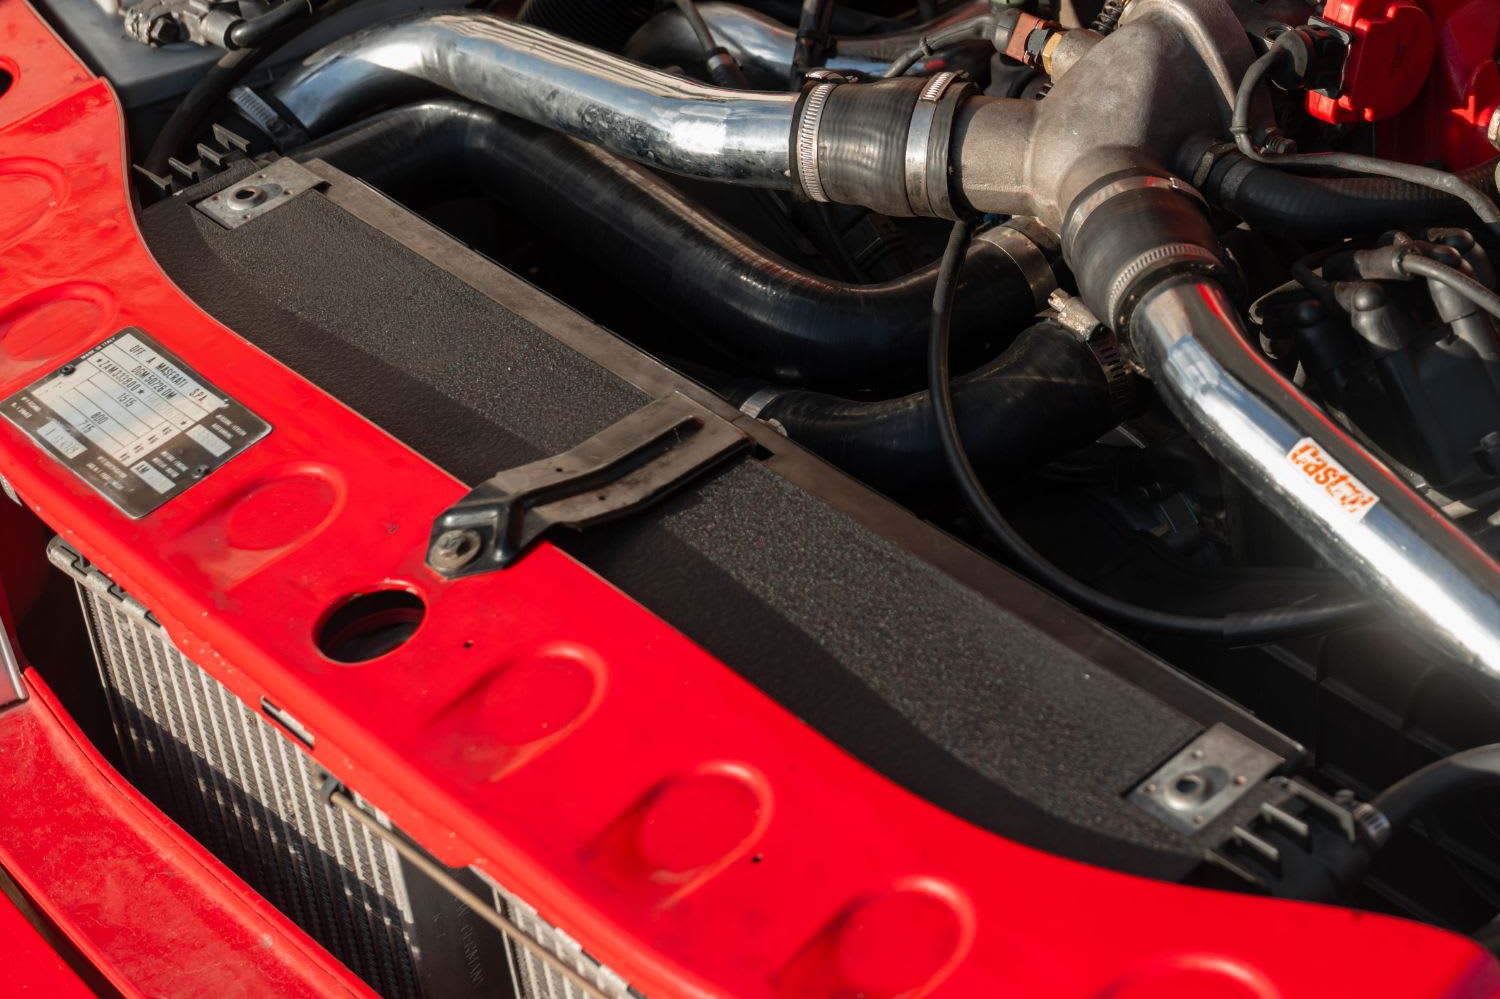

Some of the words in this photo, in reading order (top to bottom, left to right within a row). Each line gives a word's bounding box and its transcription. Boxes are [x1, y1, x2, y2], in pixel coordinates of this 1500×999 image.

[155, 362, 188, 388] MASERATI
[117, 393, 136, 408] 1515
[1290, 443, 1375, 513] Castol
